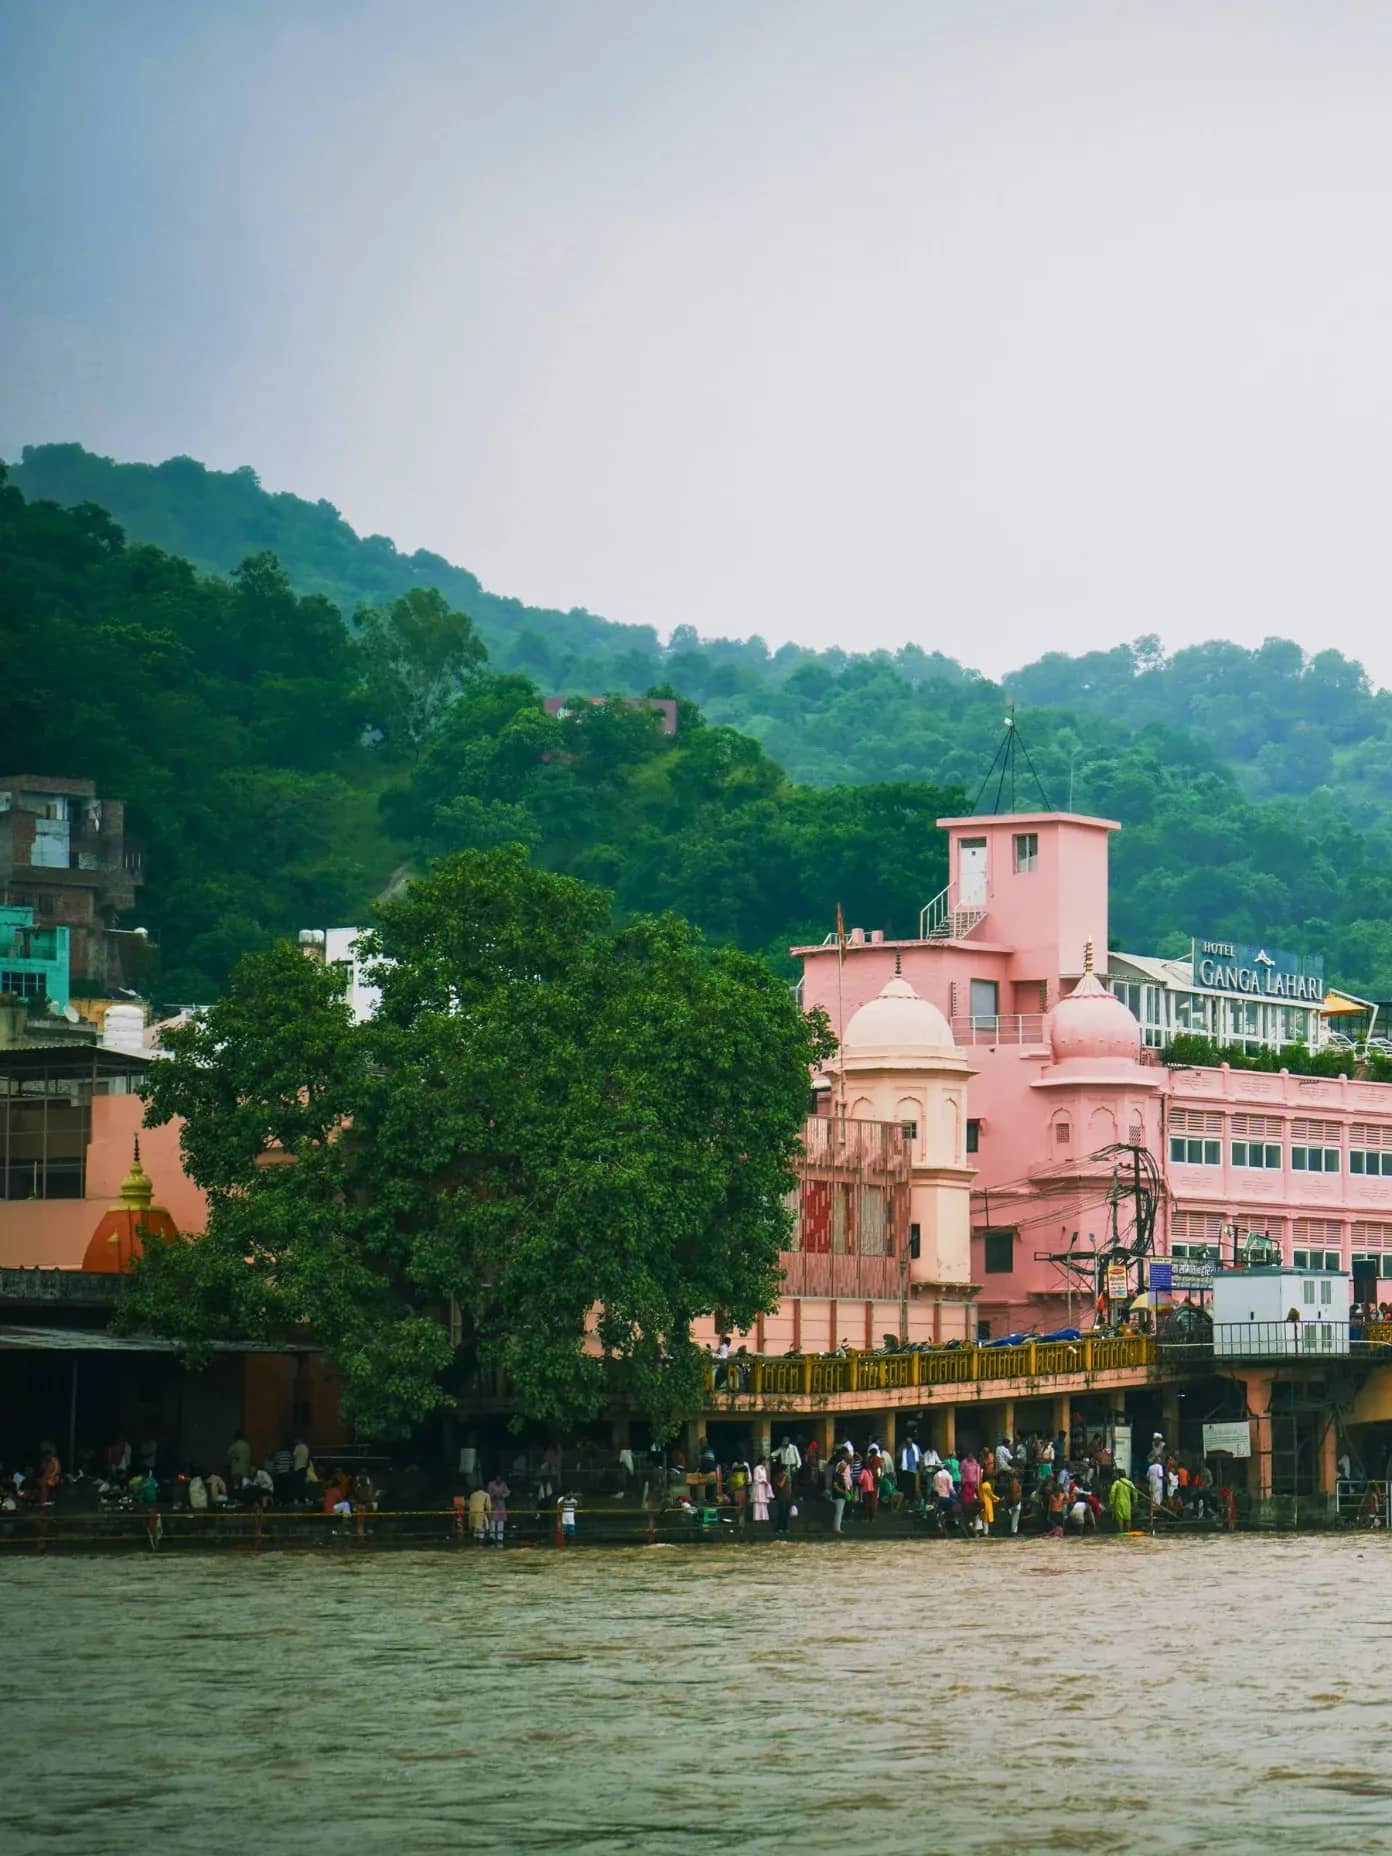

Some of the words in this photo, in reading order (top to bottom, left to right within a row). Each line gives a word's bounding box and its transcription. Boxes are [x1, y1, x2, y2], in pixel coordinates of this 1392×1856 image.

[1203, 941, 1235, 957] HOTEL
[1200, 959, 1260, 993] GANGA
[1265, 967, 1324, 1000] LAHARI
